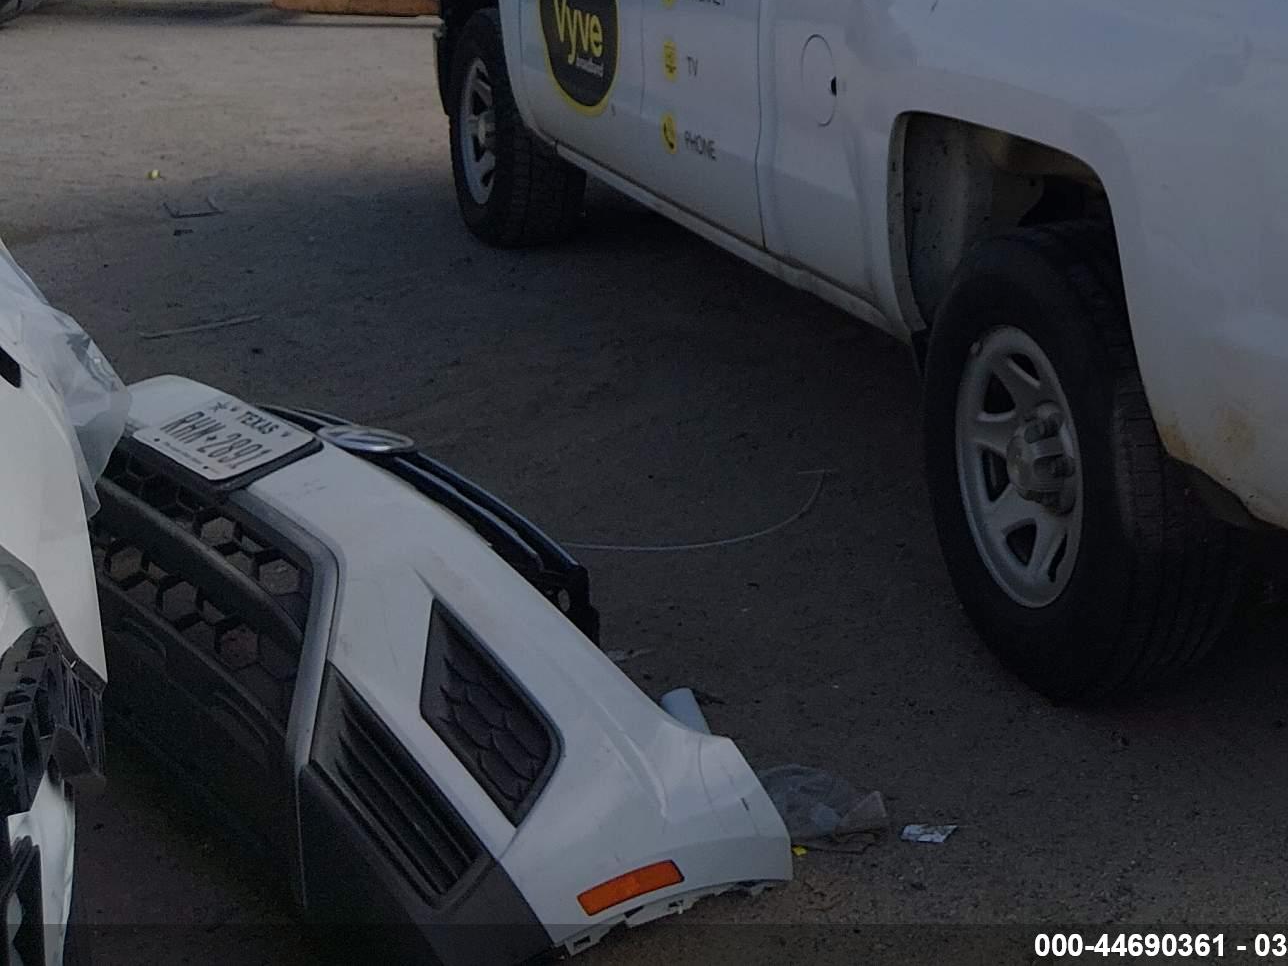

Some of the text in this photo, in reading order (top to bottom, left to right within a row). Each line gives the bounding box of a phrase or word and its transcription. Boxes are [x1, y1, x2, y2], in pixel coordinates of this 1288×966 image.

[687, 56, 699, 77] TV
[684, 130, 717, 161] PHONE
[236, 410, 280, 435] TEXAS
